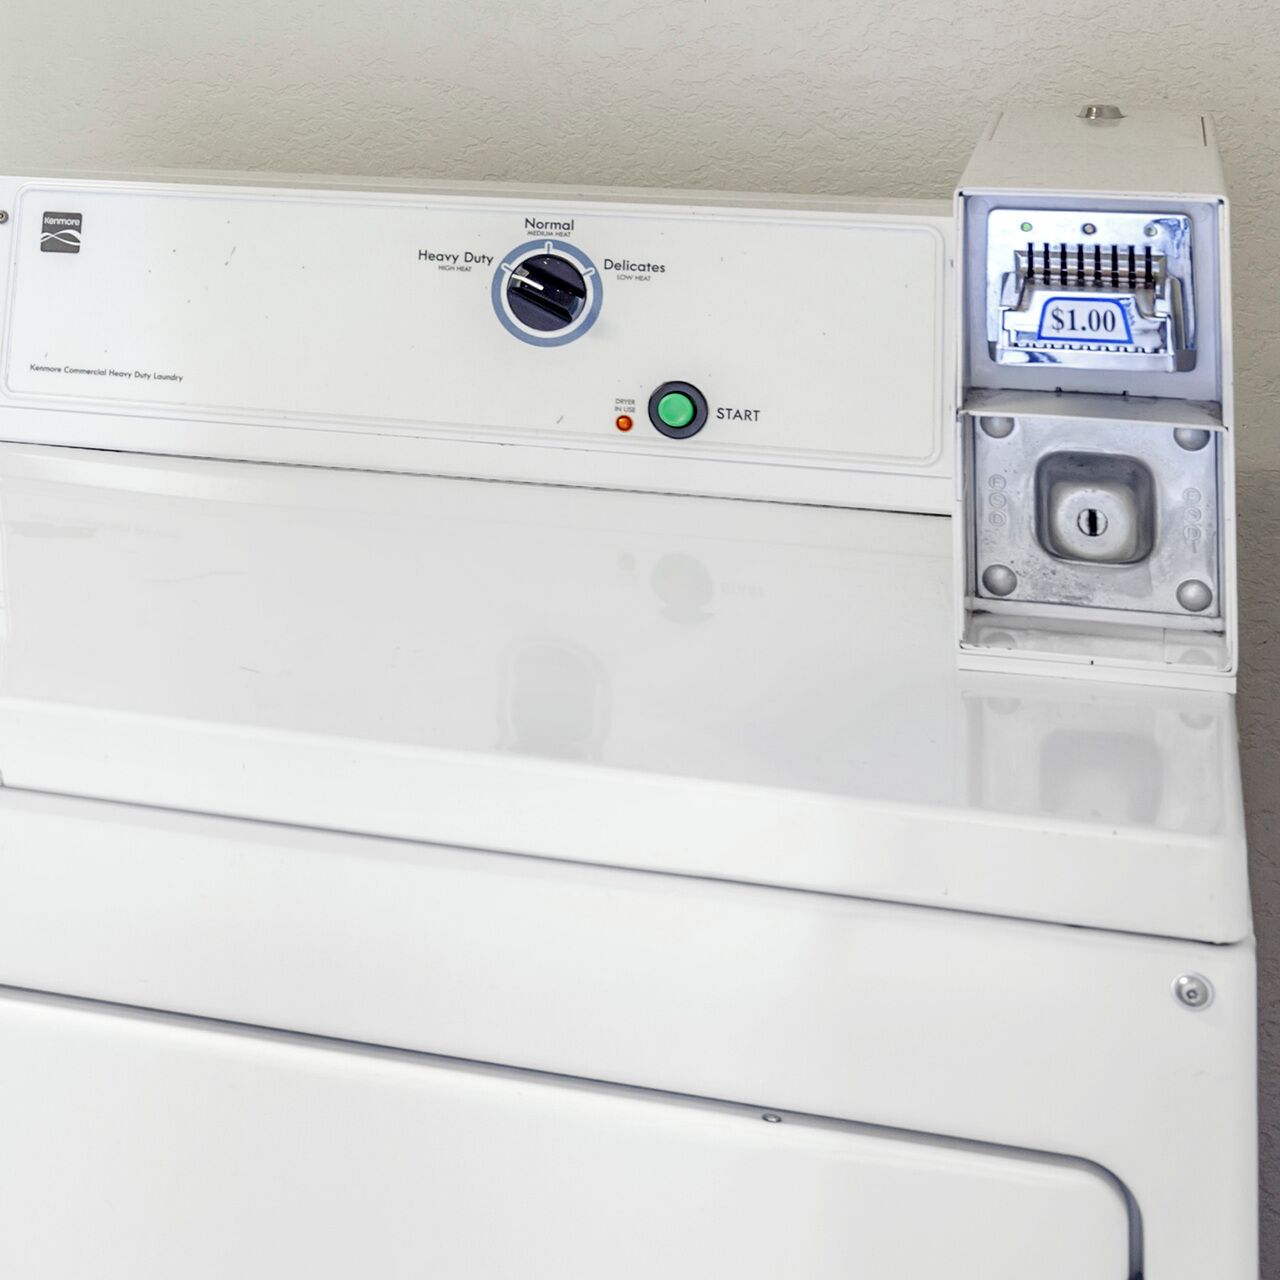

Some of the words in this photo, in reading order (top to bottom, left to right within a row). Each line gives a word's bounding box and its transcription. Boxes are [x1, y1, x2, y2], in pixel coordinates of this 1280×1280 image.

[43, 216, 81, 226] Kenmore
[524, 217, 575, 231] Normal
[418, 249, 460, 264] Heavy
[464, 251, 494, 267] Duty
[603, 258, 666, 273] Delicates
[1050, 307, 1117, 333] $1.00
[29, 363, 62, 373] Kenmore
[63, 366, 107, 376] Commercial
[108, 369, 132, 379] Heavy
[134, 371, 151, 380] Duty
[153, 372, 184, 382] Laundry
[716, 407, 761, 422] START
